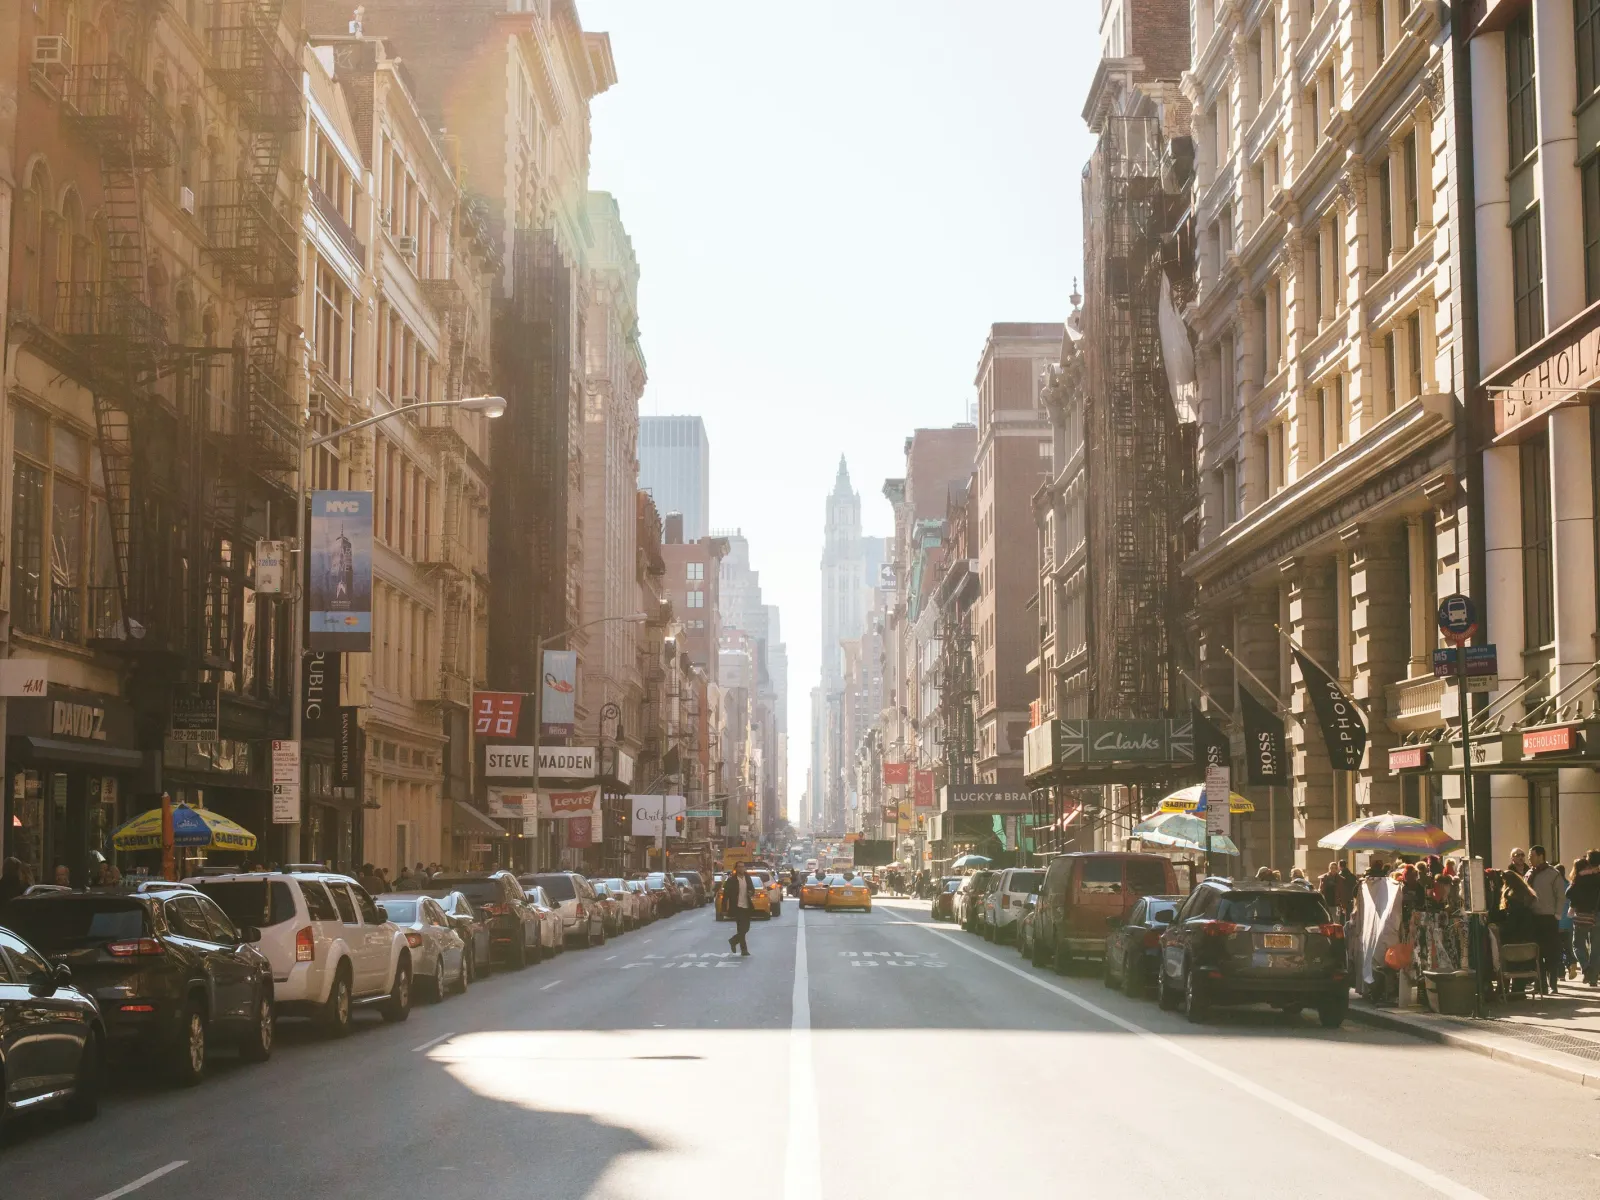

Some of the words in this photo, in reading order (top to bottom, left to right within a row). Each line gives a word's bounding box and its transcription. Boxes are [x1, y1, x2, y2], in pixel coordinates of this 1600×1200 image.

[326, 501, 359, 513] NYC
[1434, 651, 1447, 662] M5
[1435, 664, 1448, 675] M5
[23, 679, 43, 693] H&M
[1326, 682, 1355, 764] SEPHORA
[274, 741, 280, 750] 3
[1094, 731, 1160, 750] Clarks
[1529, 733, 1568, 749] SCHOLASTIC
[1259, 733, 1273, 775] BOSS
[489, 754, 529, 768] STEVE
[538, 755, 592, 769] MADDEN
[275, 785, 281, 794] 2
[953, 793, 993, 802] LUCKY
[1165, 801, 1197, 809] SABRETT
[215, 832, 255, 848] SABRETT
[620, 961, 742, 969] FIRE
[851, 960, 949, 968] BUS
